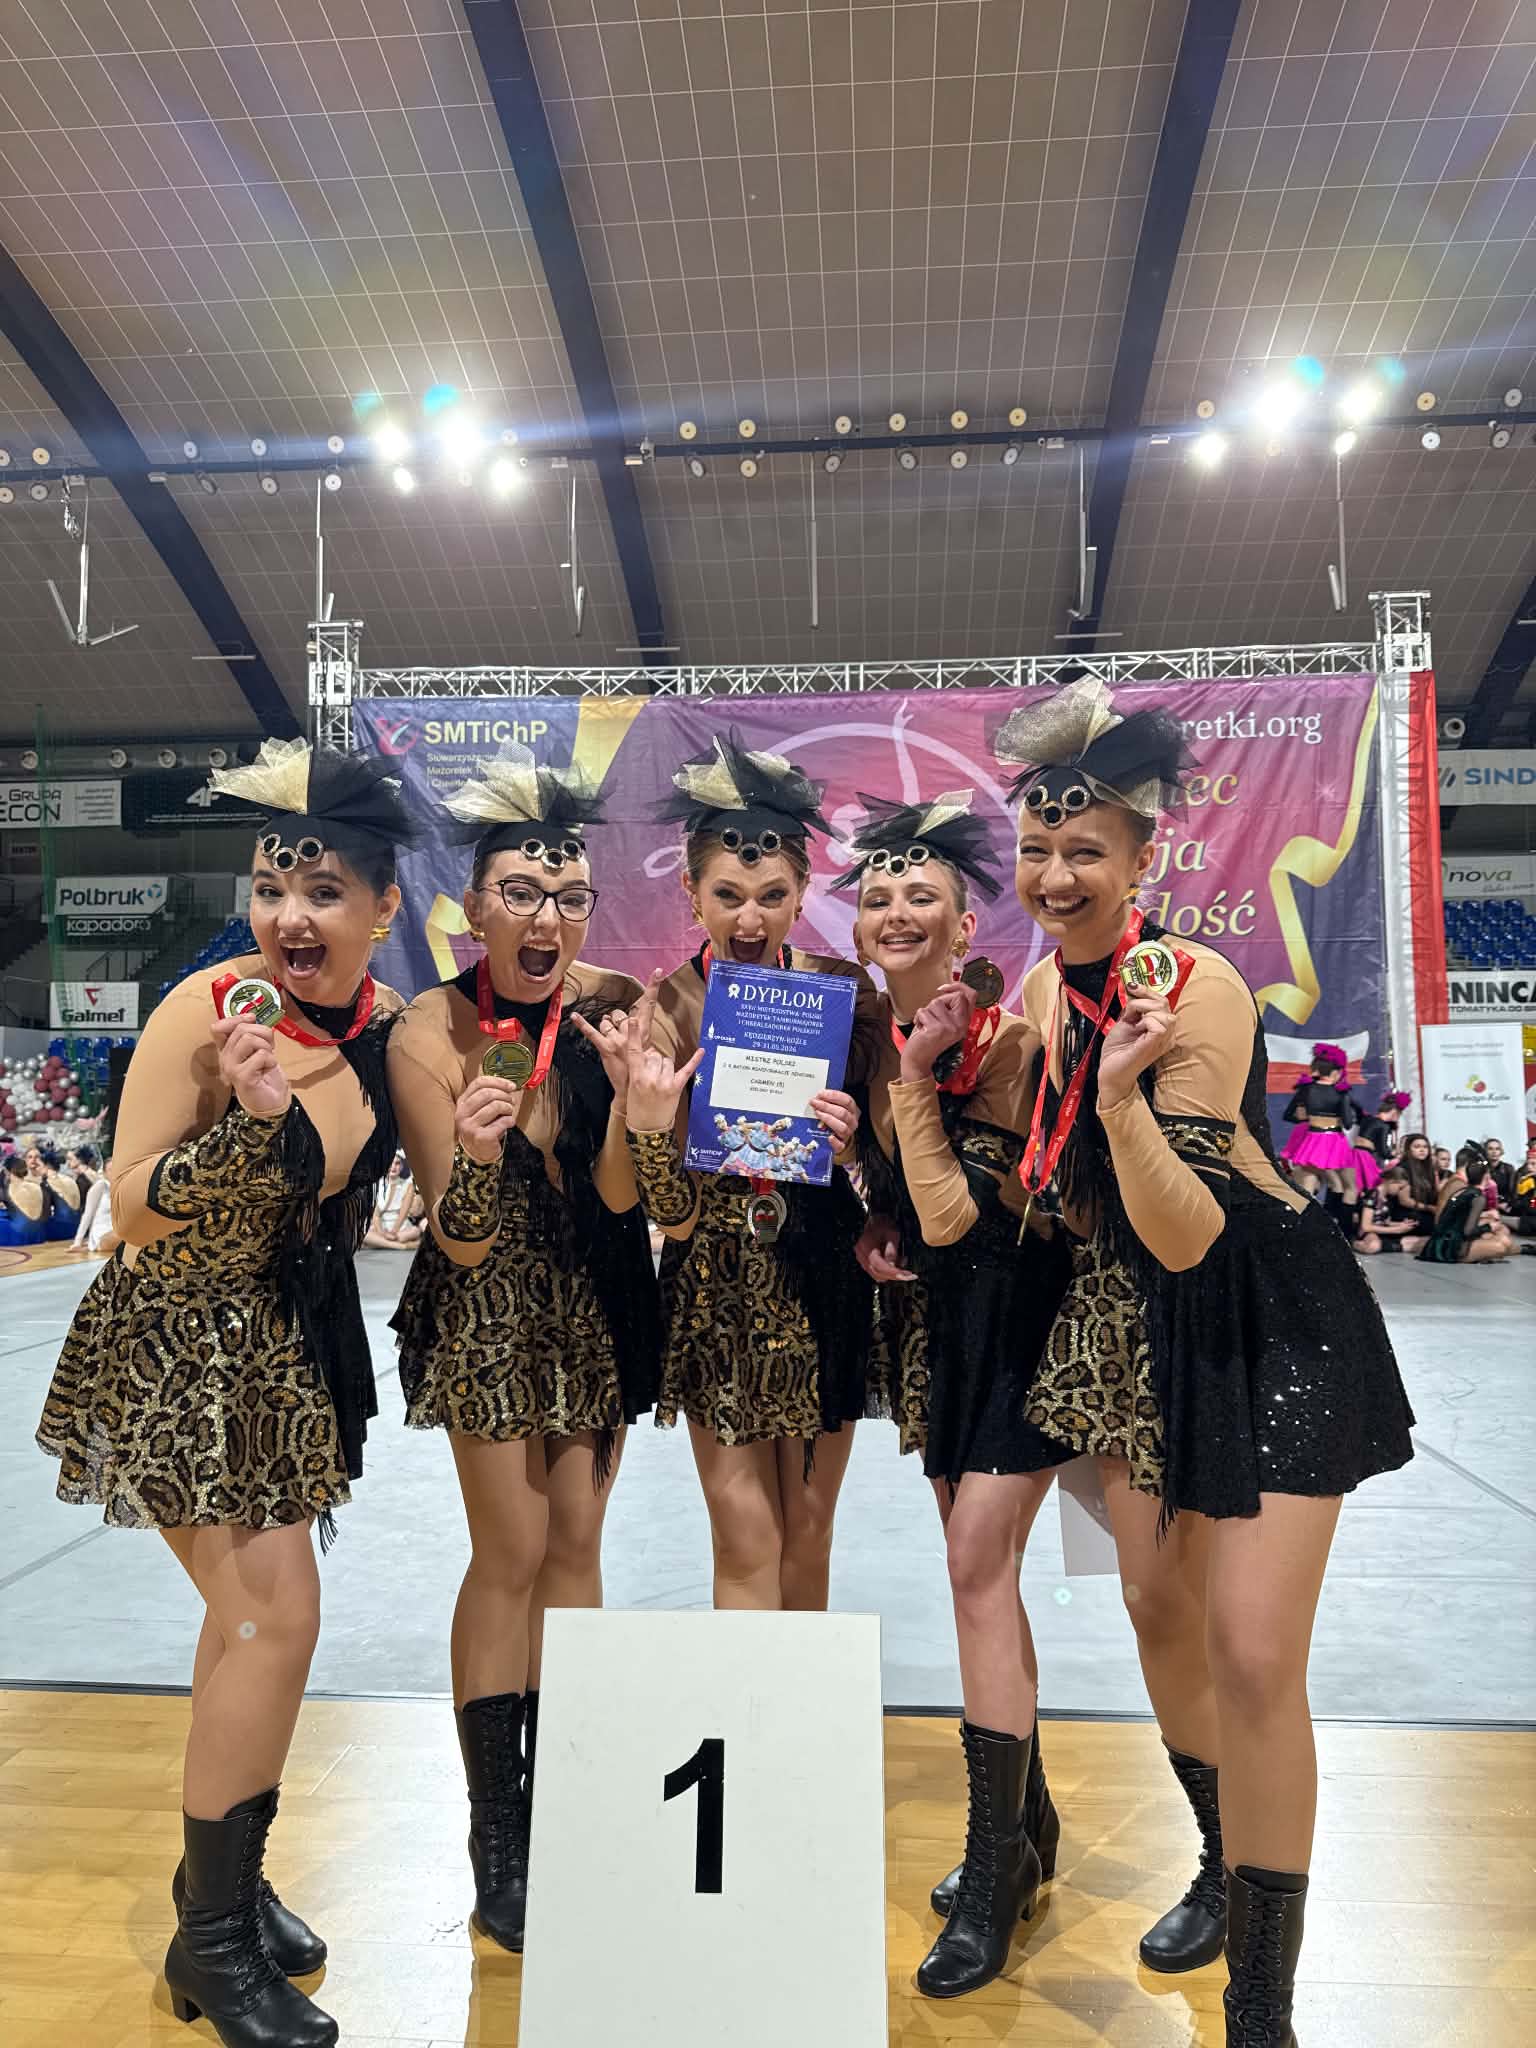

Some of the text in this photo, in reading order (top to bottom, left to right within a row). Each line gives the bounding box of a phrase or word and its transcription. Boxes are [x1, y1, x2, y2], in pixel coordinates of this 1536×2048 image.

[424, 720, 548, 744] SMTiChP
[1147, 828, 1207, 884] ja
[60, 888, 145, 906] Polbruk
[1146, 890, 1256, 937] dość
[744, 984, 824, 1011] DYPLOM
[1446, 982, 1536, 1004] NINC
[62, 1008, 126, 1022] Galmet
[664, 1738, 725, 1894] 1
